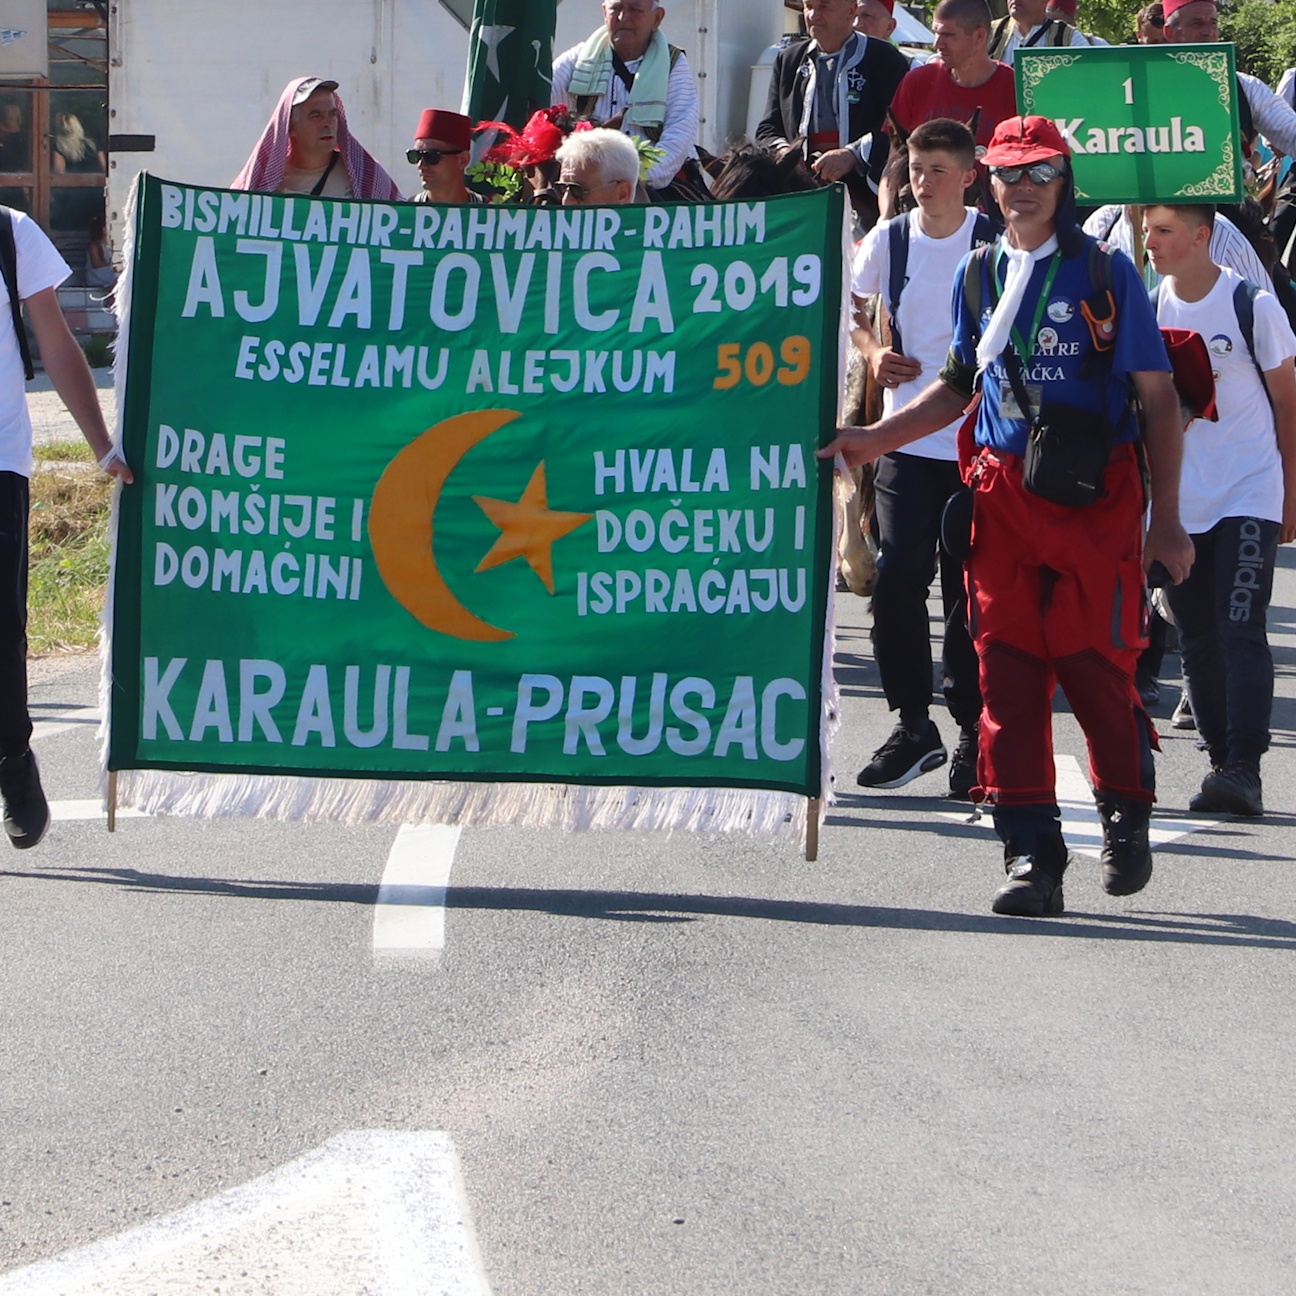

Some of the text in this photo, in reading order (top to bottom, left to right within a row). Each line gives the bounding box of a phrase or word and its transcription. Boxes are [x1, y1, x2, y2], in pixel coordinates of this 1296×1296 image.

[1121, 76, 1135, 105] 1
[1054, 116, 1206, 154] Karaula
[181, 235, 822, 334] AJVATOVICA 2019
[235, 335, 812, 395] ESSELAMU ALEJKUM 509
[156, 424, 286, 480] DRAGE
[593, 444, 807, 495] HVALA NA
[155, 483, 364, 542] KOMŠIJE I
[595, 498, 806, 553] DOČEKU I
[154, 541, 363, 601] DOMAĆINI
[577, 557, 807, 616] ISPRAĆAJU
[1229, 520, 1265, 622] adidas
